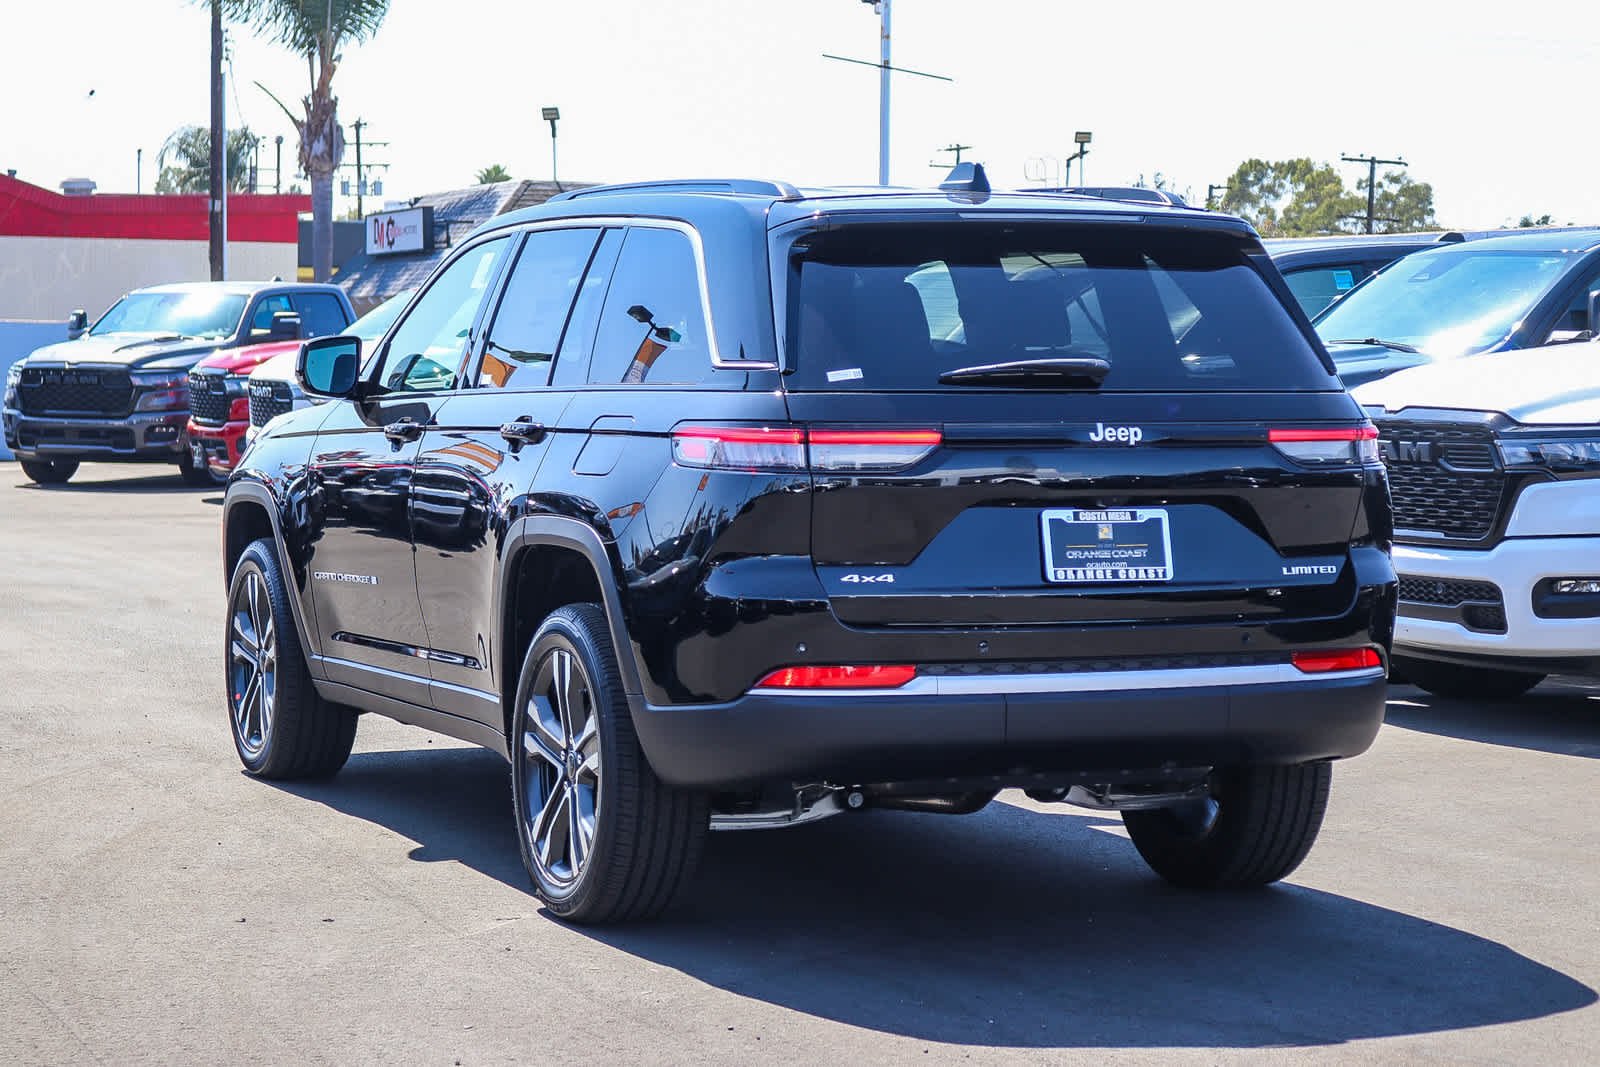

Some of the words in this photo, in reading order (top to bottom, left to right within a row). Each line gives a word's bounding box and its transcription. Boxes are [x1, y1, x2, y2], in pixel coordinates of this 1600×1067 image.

[251, 386, 272, 398] RAM
[1089, 422, 1142, 445] Jeep
[1377, 440, 1432, 461] AM
[1079, 511, 1107, 521] COSTA
[1107, 511, 1132, 521] MESA
[1066, 550, 1111, 559] ORANGE
[1112, 549, 1148, 558] COAST
[1056, 569, 1113, 580] ORANGE
[1118, 568, 1165, 579] COAST
[1282, 565, 1337, 575] LIMITED
[840, 574, 894, 583] 4x4
